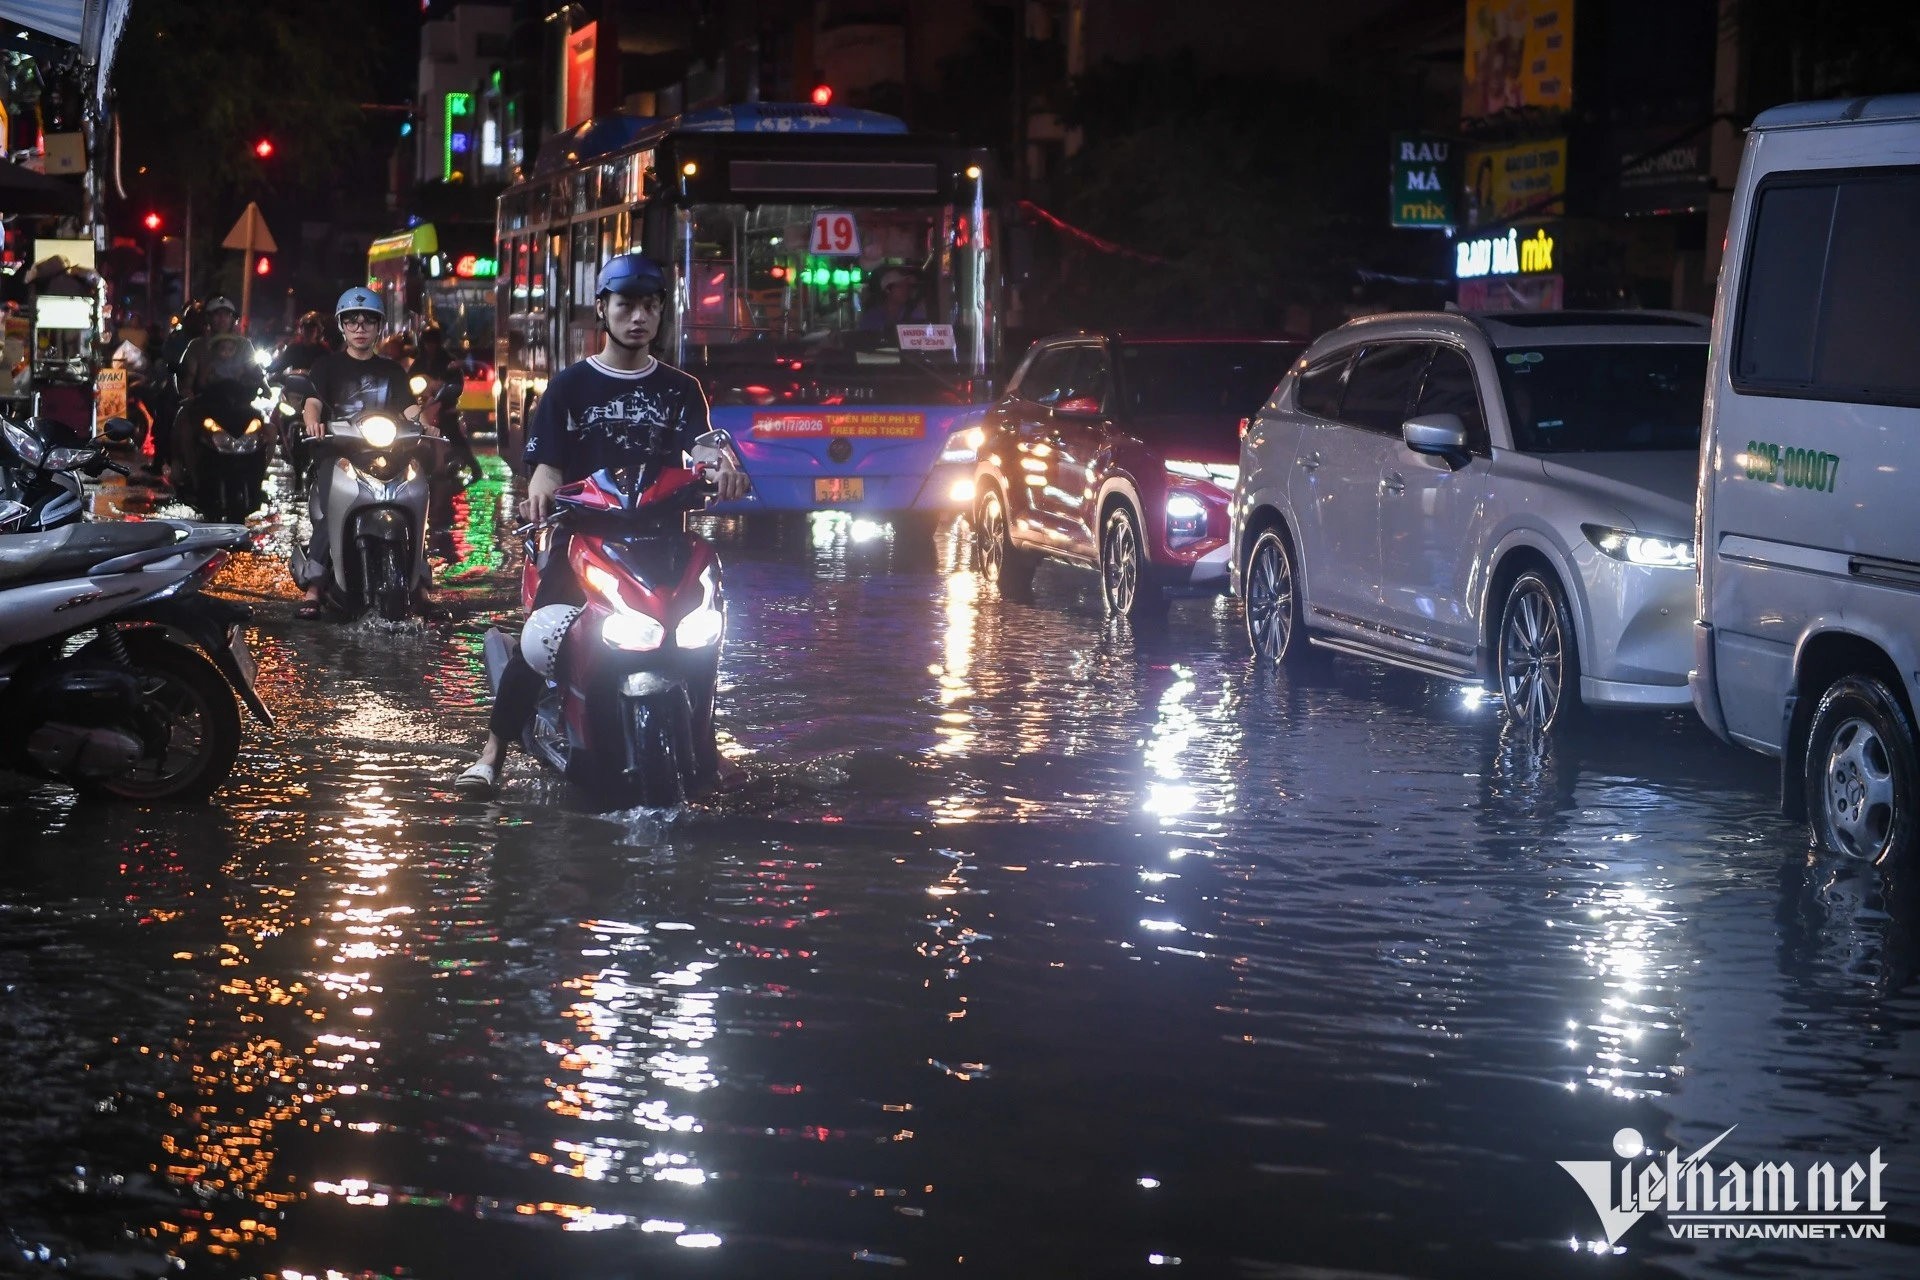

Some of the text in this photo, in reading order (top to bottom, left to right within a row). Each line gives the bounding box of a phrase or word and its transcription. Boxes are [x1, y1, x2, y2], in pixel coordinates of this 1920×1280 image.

[1401, 141, 1449, 161] RAU
[1407, 166, 1442, 190] MÁ
[1402, 200, 1446, 220] mix
[816, 216, 853, 251] 19
[1521, 229, 1553, 272] mix
[774, 419, 824, 432] 01/7/2026
[830, 426, 915, 435] FREE BUS TICKET
